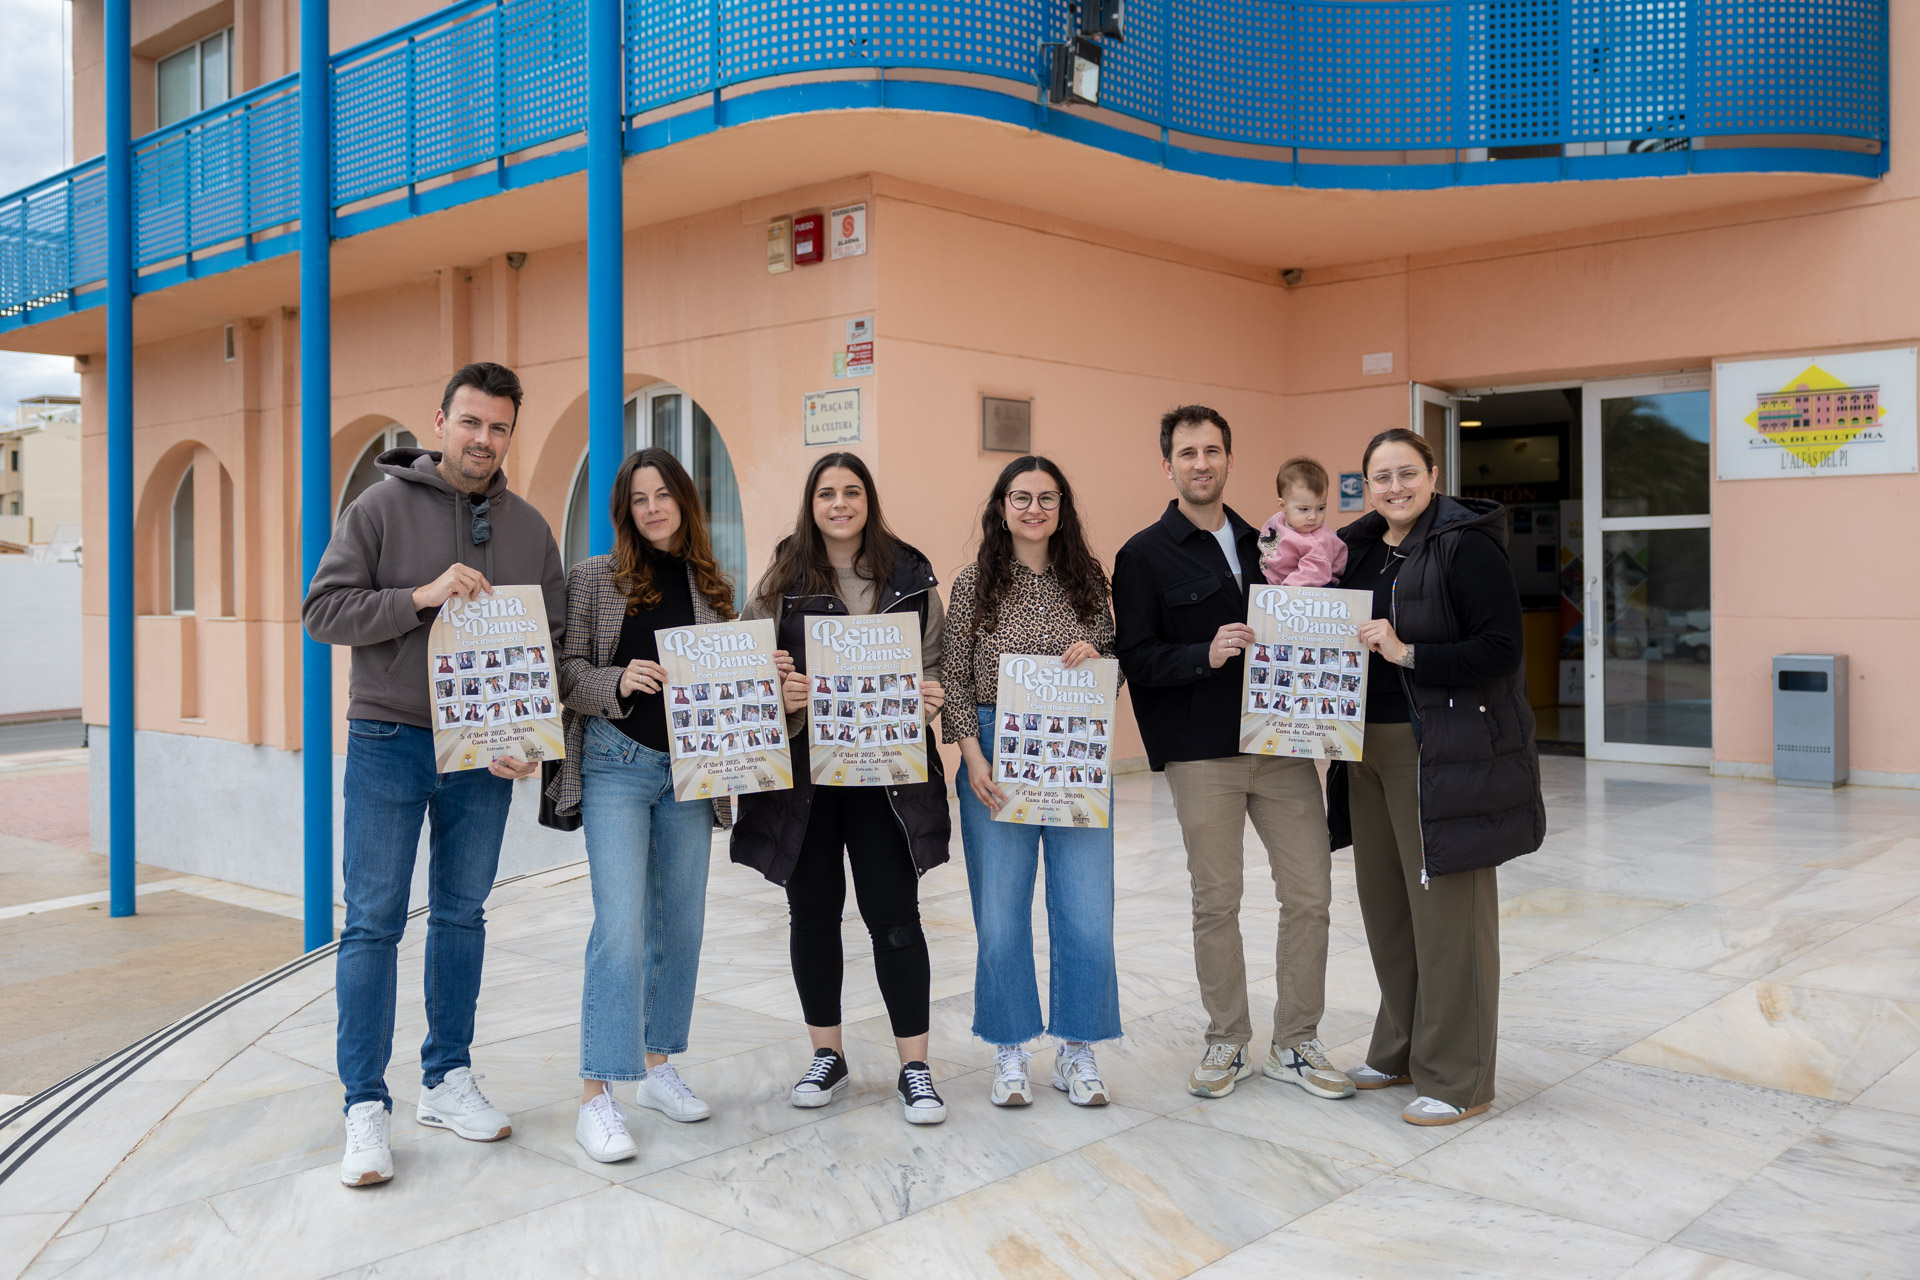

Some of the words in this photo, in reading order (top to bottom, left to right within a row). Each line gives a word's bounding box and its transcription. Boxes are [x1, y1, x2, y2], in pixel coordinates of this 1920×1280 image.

[795, 222, 814, 232] FUEGO
[838, 238, 859, 246] ALARMA
[849, 344, 872, 352] Alarma
[821, 402, 842, 413] PLAÇA
[845, 401, 854, 410] DE
[812, 424, 820, 433] LA
[822, 421, 852, 432] CULTURA
[1813, 432, 1883, 442] CULTURA
[1820, 450, 1838, 469] DEL
[1840, 450, 1848, 467] PI
[1465, 484, 1537, 501] MACIÓN
[437, 597, 527, 628] Reina
[1256, 589, 1351, 622] Reina
[456, 631, 461, 640] i
[465, 618, 539, 637] Dames
[811, 619, 904, 652] Reina
[1278, 624, 1282, 633] i
[1287, 615, 1358, 637] Dames
[664, 629, 758, 661] Reina
[835, 655, 840, 664] i
[844, 645, 913, 663] Dames
[691, 664, 696, 672] i
[699, 652, 769, 670] Dames
[1006, 658, 1098, 691] Reina
[1026, 693, 1031, 702] i
[1036, 684, 1105, 705] Dames
[1316, 724, 1337, 732] 20:00h
[703, 761, 724, 769] d'Abril
